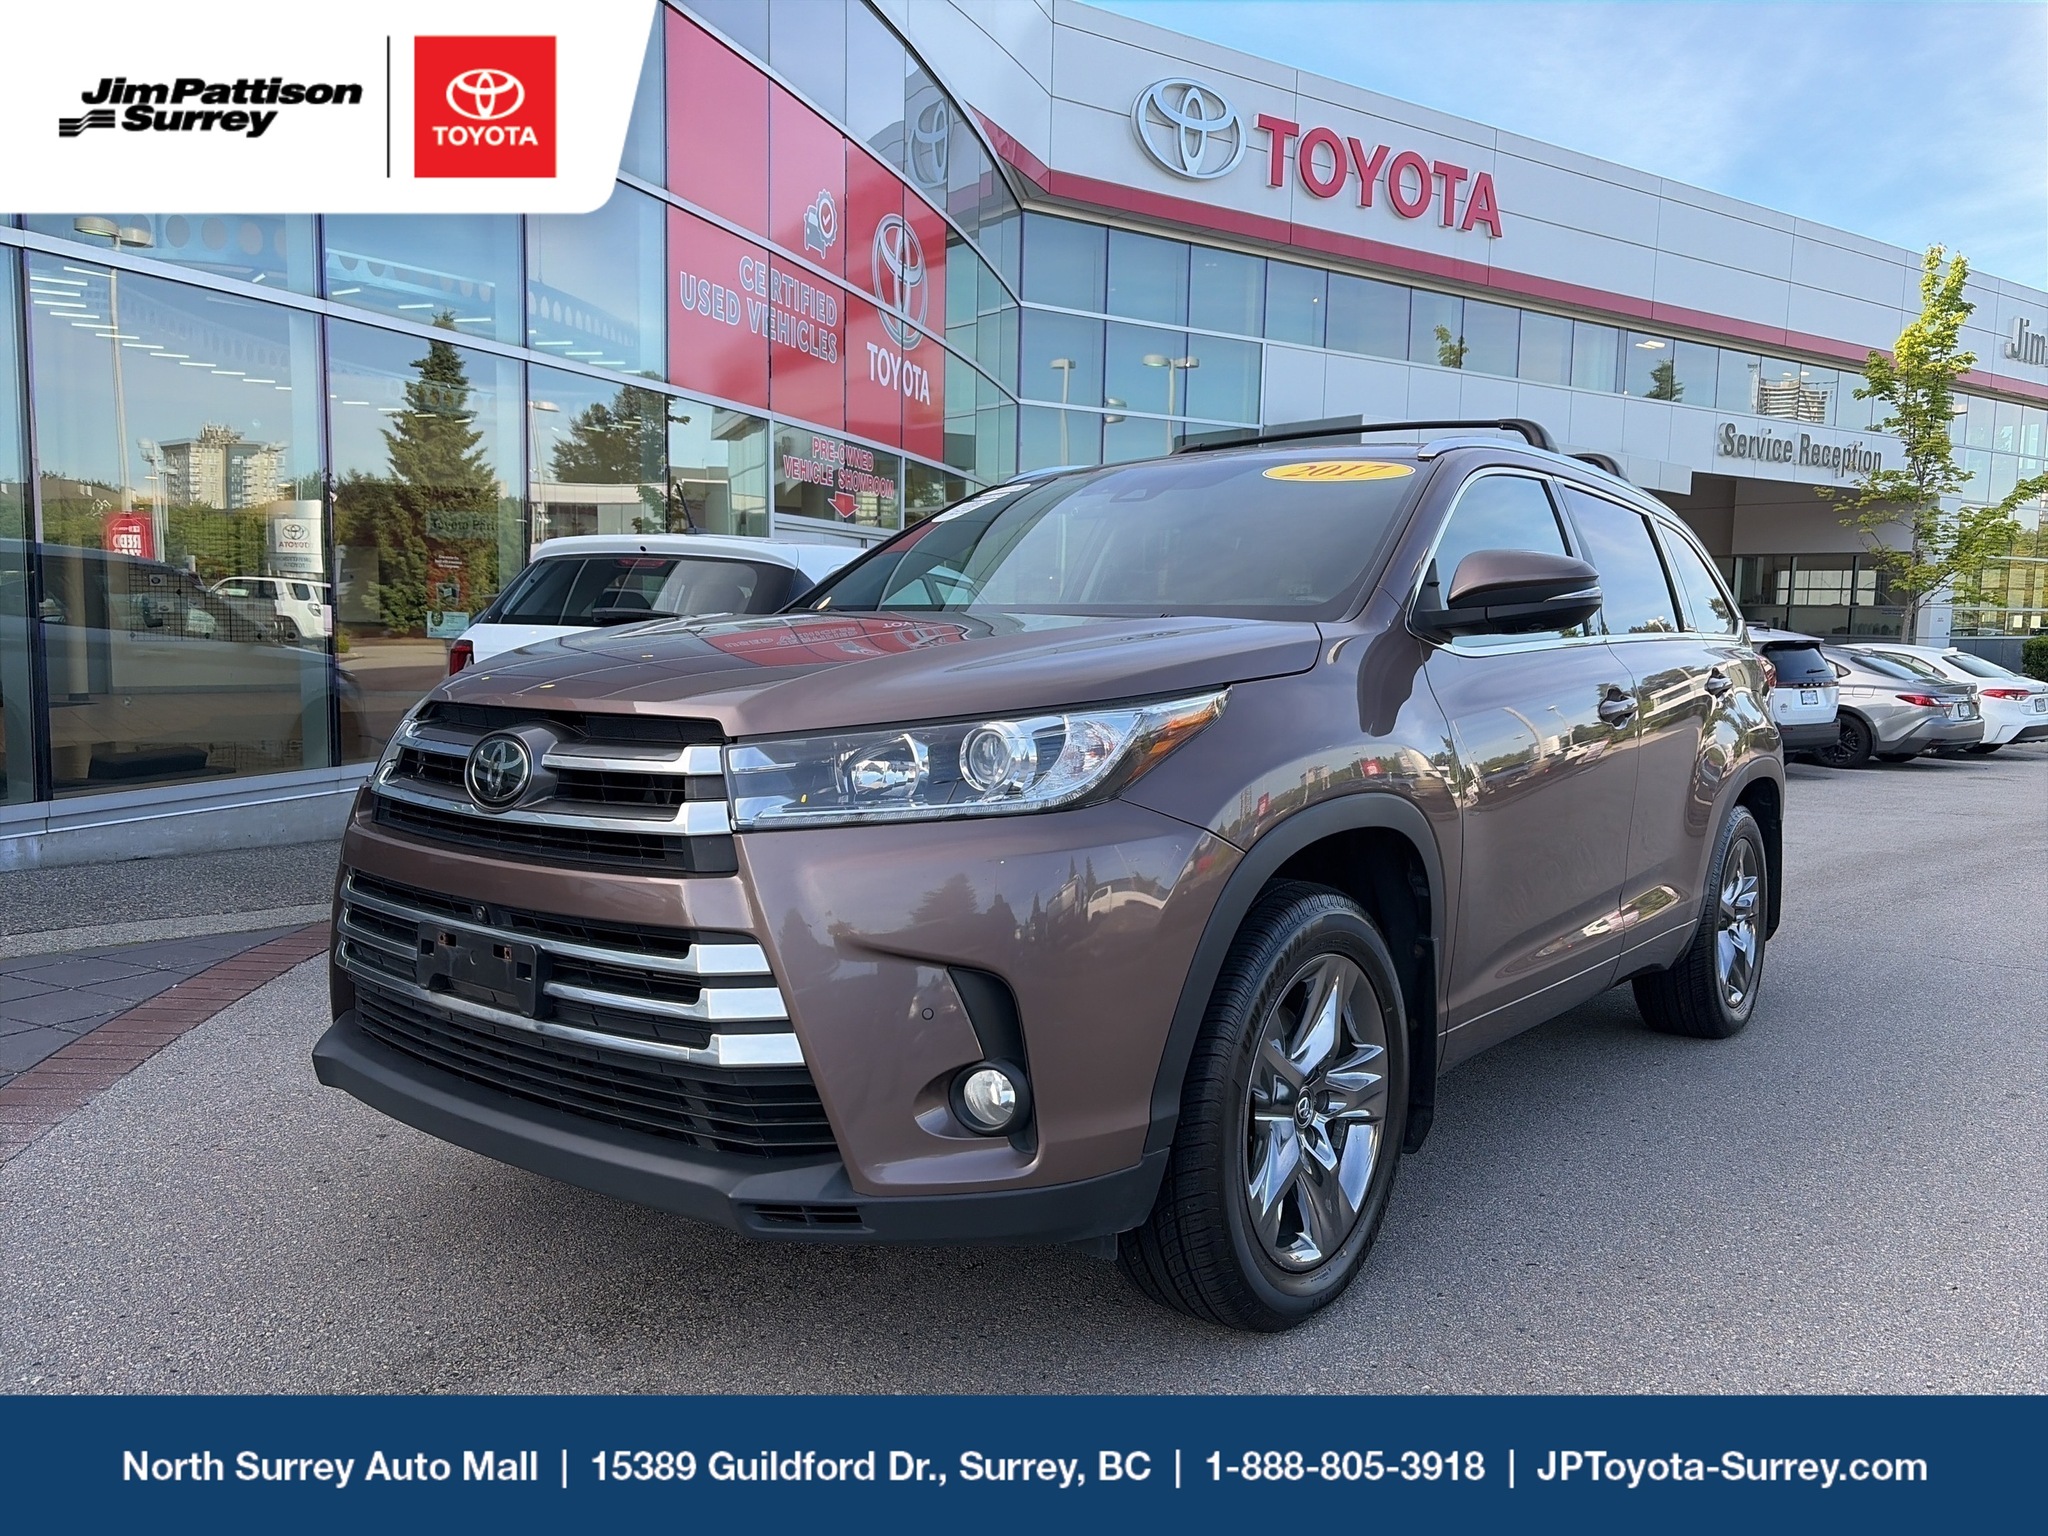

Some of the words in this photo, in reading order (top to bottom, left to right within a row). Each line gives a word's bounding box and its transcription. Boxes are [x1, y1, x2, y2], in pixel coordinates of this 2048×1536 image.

[1253, 113, 1503, 239] TOYOTA
[680, 270, 741, 326] USED
[747, 298, 838, 364] VEHICLES
[739, 255, 838, 328] CERTIFIED
[2005, 317, 2047, 366] Jim
[866, 341, 931, 406] TOYOTA
[783, 454, 834, 487] VEHICLE
[838, 467, 896, 499] SHOWROOM
[812, 436, 875, 473] PRE-OWNED
[1281, 464, 1392, 477] 2017
[1718, 422, 1793, 464] Service
[1799, 433, 1882, 478] Reception
